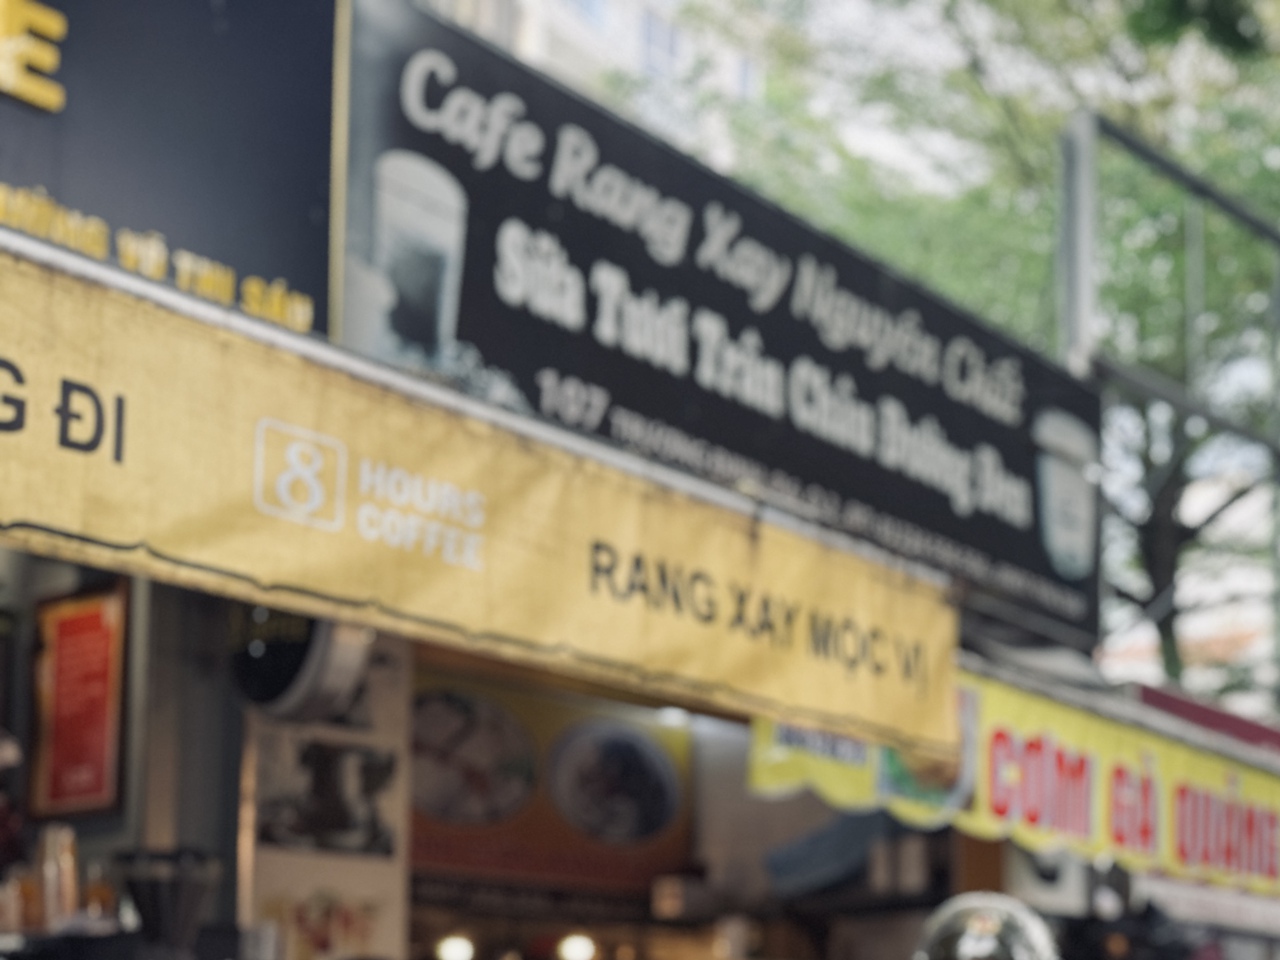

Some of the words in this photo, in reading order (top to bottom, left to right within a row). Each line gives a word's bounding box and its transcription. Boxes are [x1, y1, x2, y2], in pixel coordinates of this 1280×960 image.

[401, 49, 547, 181] Cafe
[549, 121, 694, 267] Rang
[695, 202, 793, 314] Xay
[493, 216, 588, 334] Sữa
[54, 377, 126, 464] ĐI
[274, 439, 326, 516] 8
[358, 457, 487, 529] HOURS
[356, 502, 486, 573] COFFEE
[590, 540, 717, 626] RANG
[728, 580, 804, 649] XAY
[987, 726, 1095, 842] CƠM
